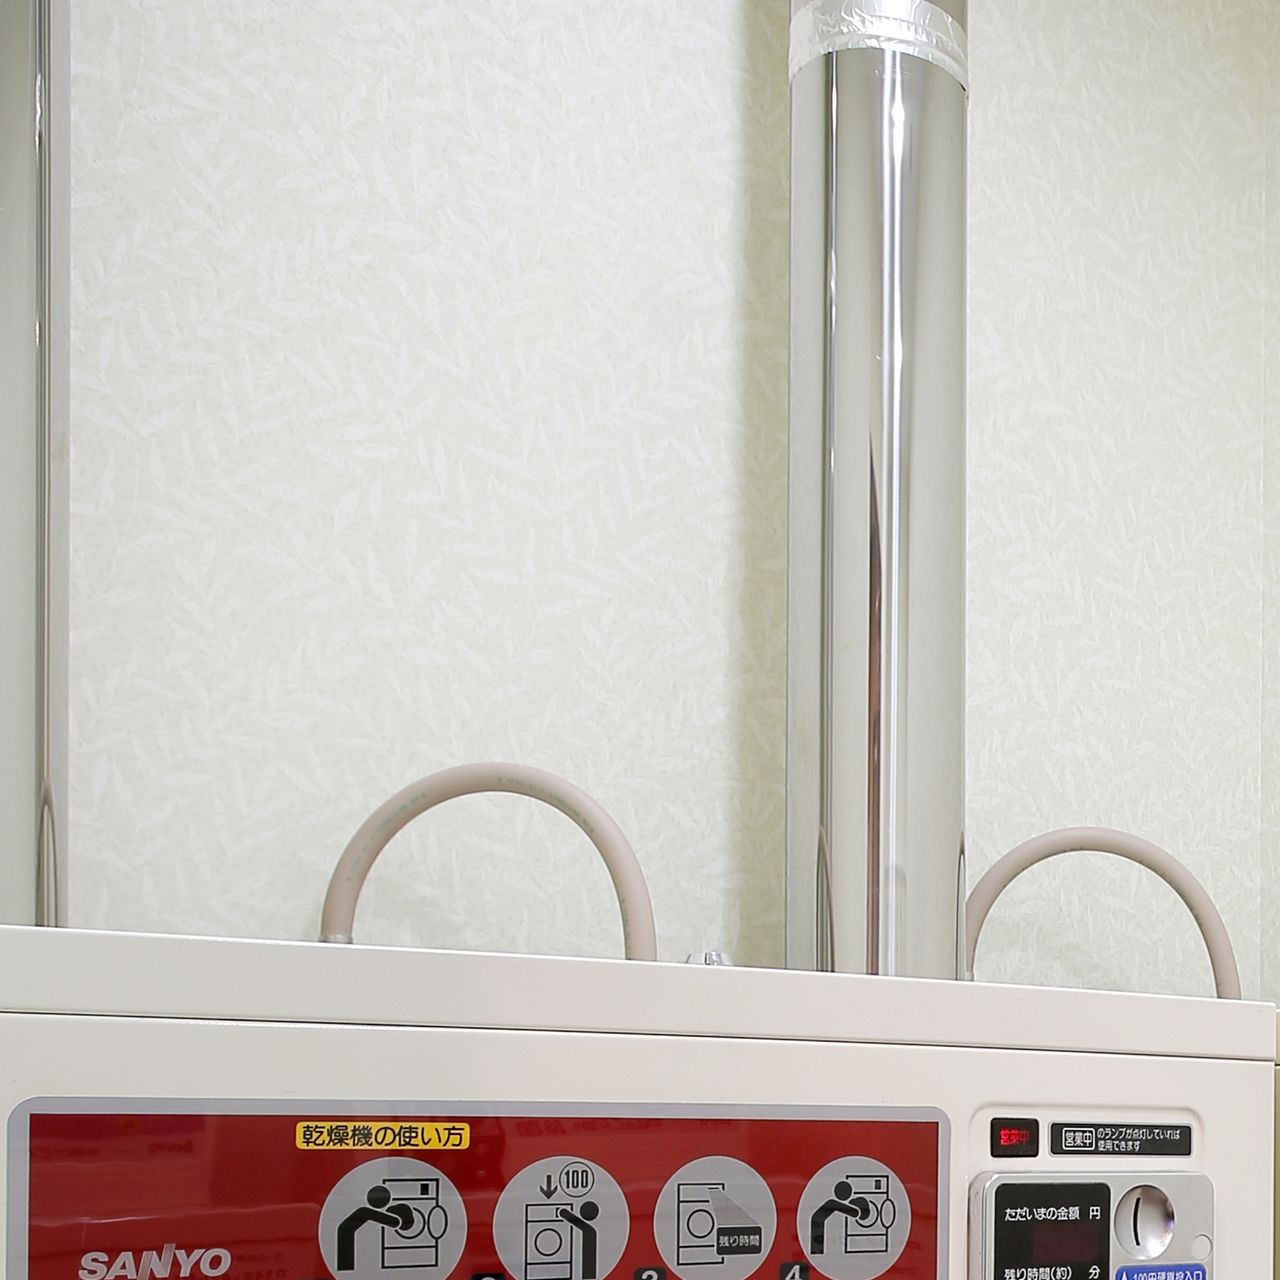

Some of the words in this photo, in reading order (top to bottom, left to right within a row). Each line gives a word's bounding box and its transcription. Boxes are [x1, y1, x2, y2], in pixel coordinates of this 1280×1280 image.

[302, 1123, 464, 1148] 乾燥機の使い方
[1065, 1132, 1092, 1147] 営業中
[1097, 1128, 1180, 1140] のランプが点灯していれば
[1097, 1141, 1140, 1152] 使用できます
[564, 1171, 589, 1188] 100
[1004, 1207, 1080, 1221] ただいまの金額
[1089, 1207, 1100, 1220] 円
[718, 1235, 760, 1248] 残り時間
[1089, 1266, 1100, 1280] 分
